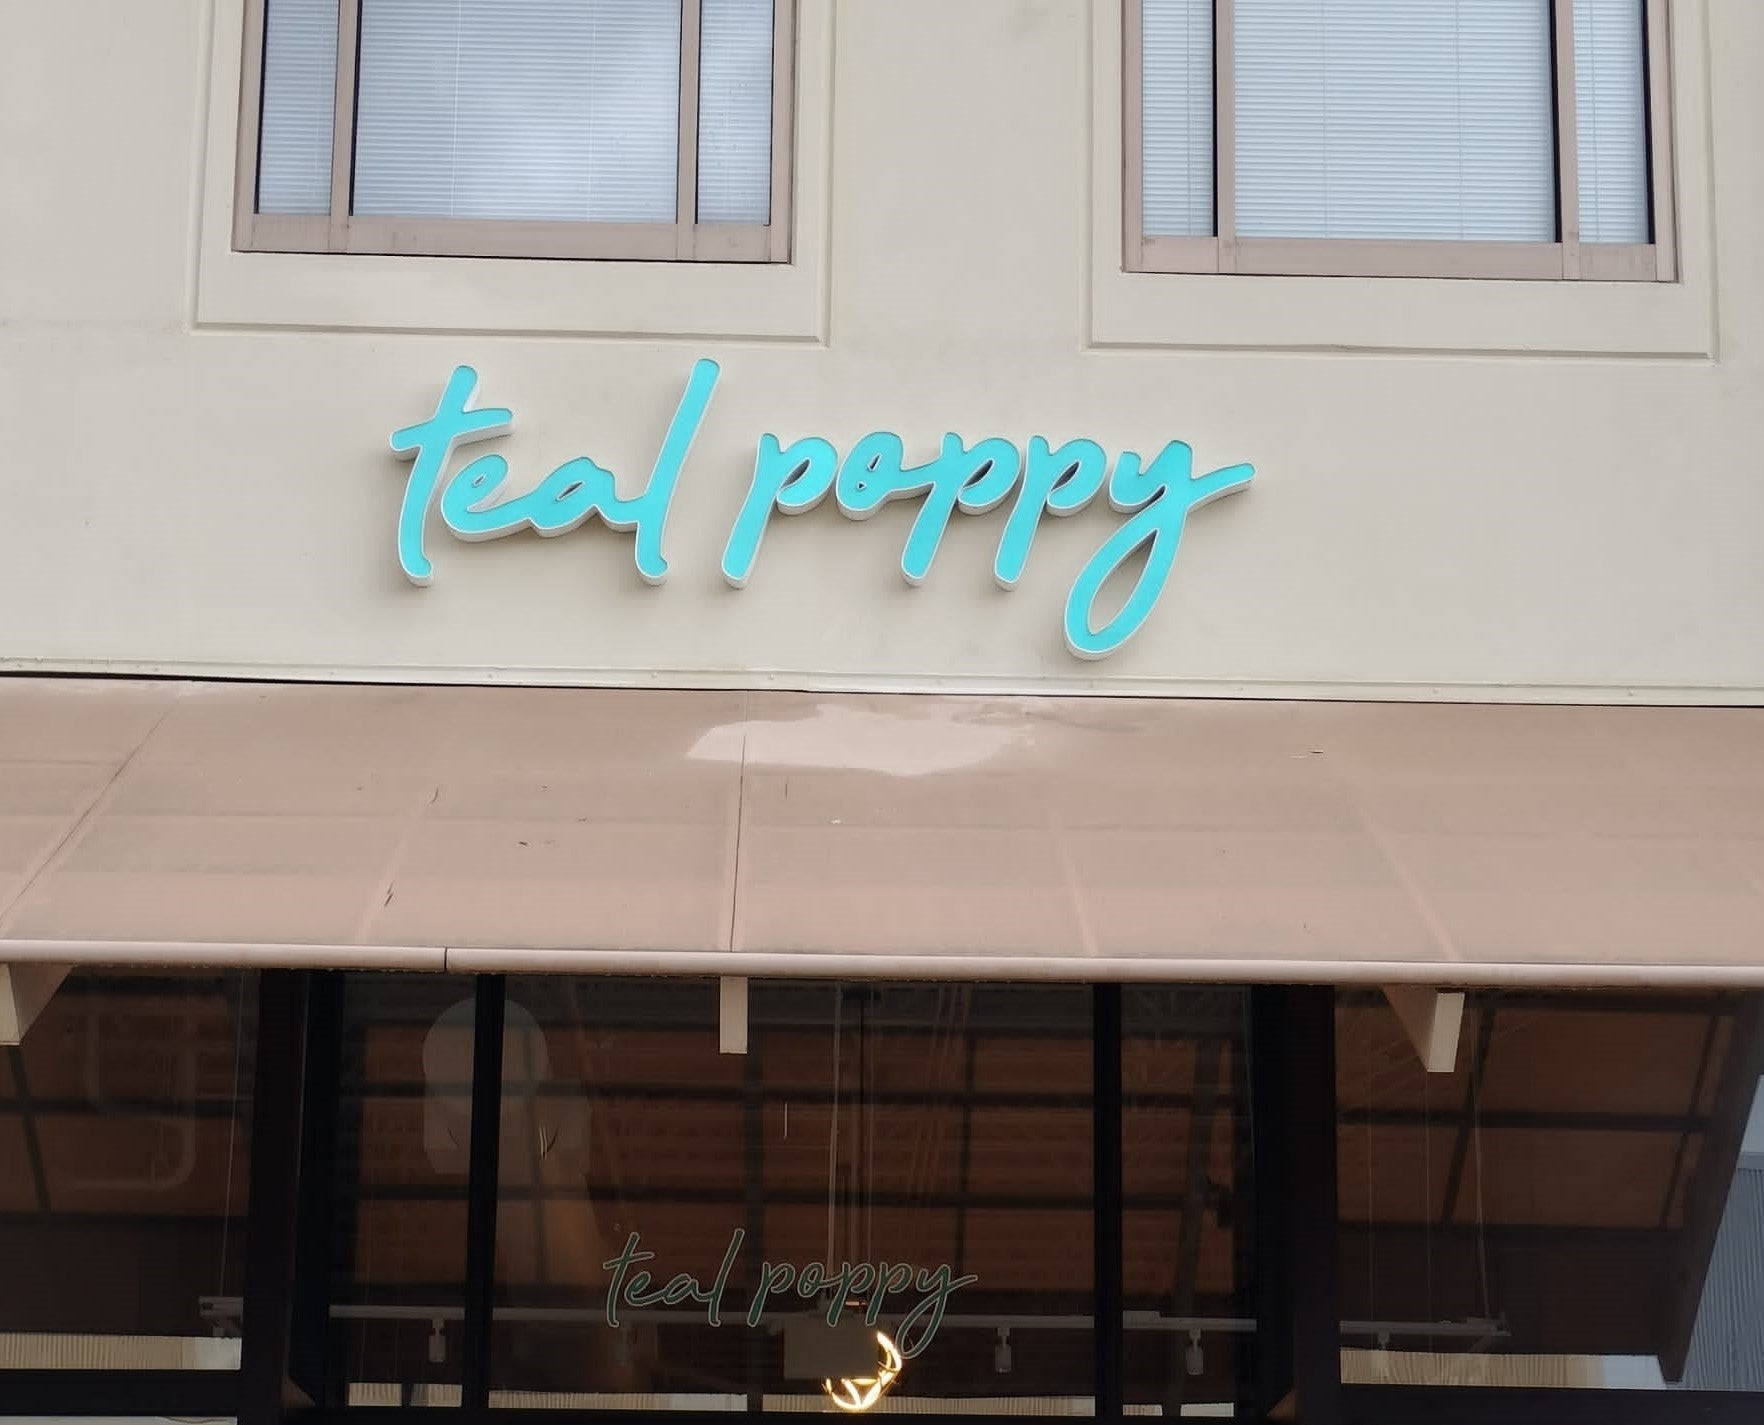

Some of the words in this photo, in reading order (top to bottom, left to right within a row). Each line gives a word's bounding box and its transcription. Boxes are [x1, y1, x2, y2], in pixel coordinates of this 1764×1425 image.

[390, 358, 721, 583] teal
[722, 431, 1256, 656] poppy
[602, 1228, 745, 1328] teal
[747, 1262, 978, 1359] poppy
